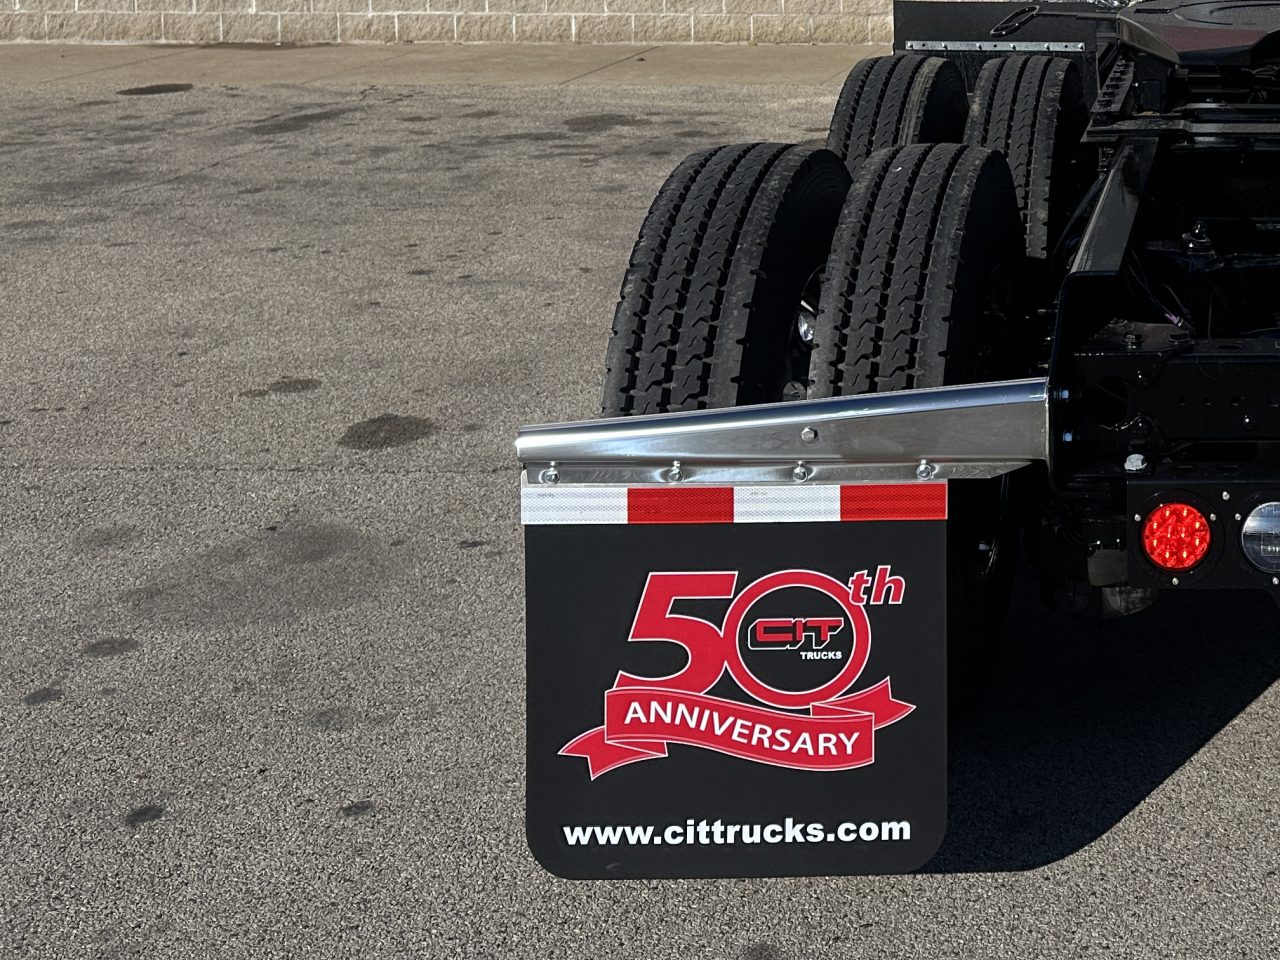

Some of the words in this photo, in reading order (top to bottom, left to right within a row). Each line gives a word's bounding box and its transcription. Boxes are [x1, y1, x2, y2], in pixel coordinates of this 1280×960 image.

[748, 618, 845, 649] CIT
[800, 651, 843, 660] TRUCKS
[624, 701, 861, 755] ANNIVERSARY
[563, 817, 912, 846] www.cittrucks.com
